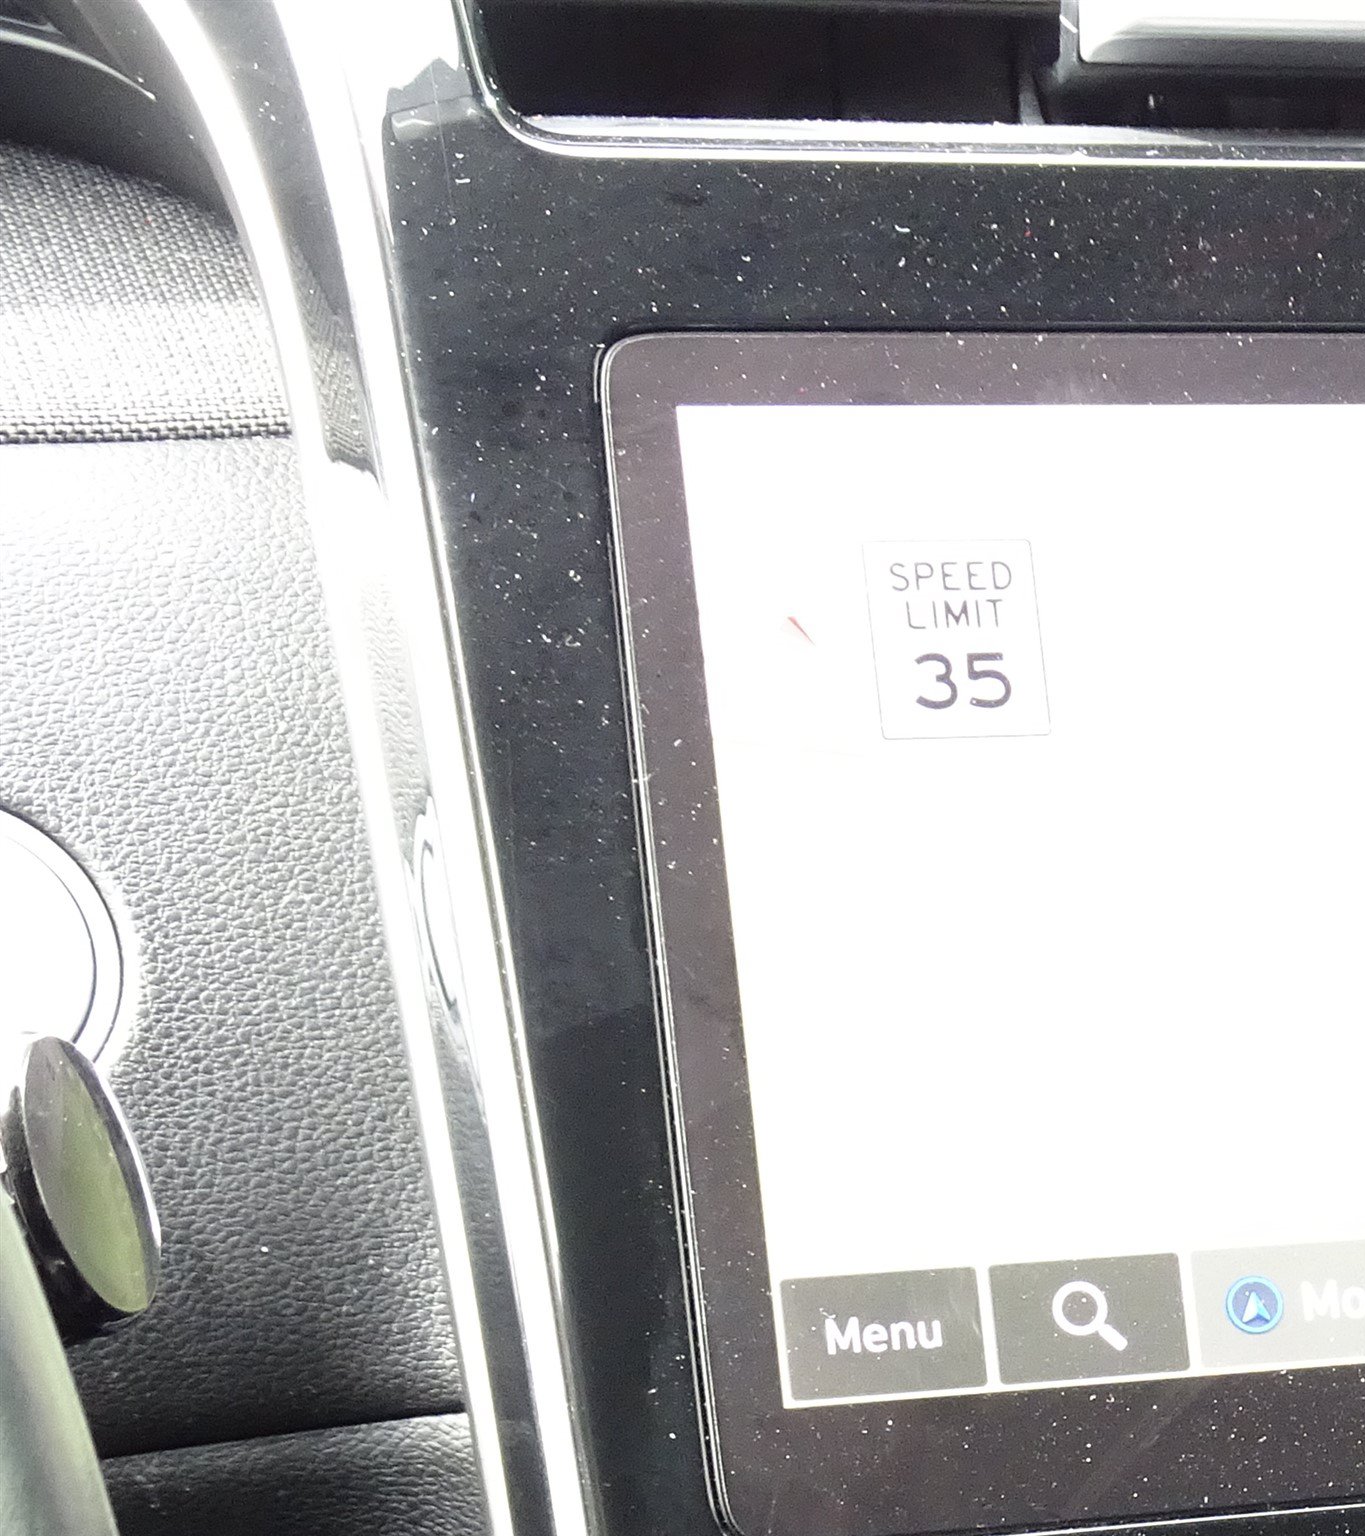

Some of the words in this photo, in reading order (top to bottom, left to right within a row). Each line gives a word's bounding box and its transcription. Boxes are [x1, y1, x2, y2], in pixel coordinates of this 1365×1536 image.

[889, 559, 1013, 593] SPEED
[905, 598, 1004, 631] LIMIT
[913, 651, 1014, 711] 35
[824, 1314, 944, 1356] Menu
